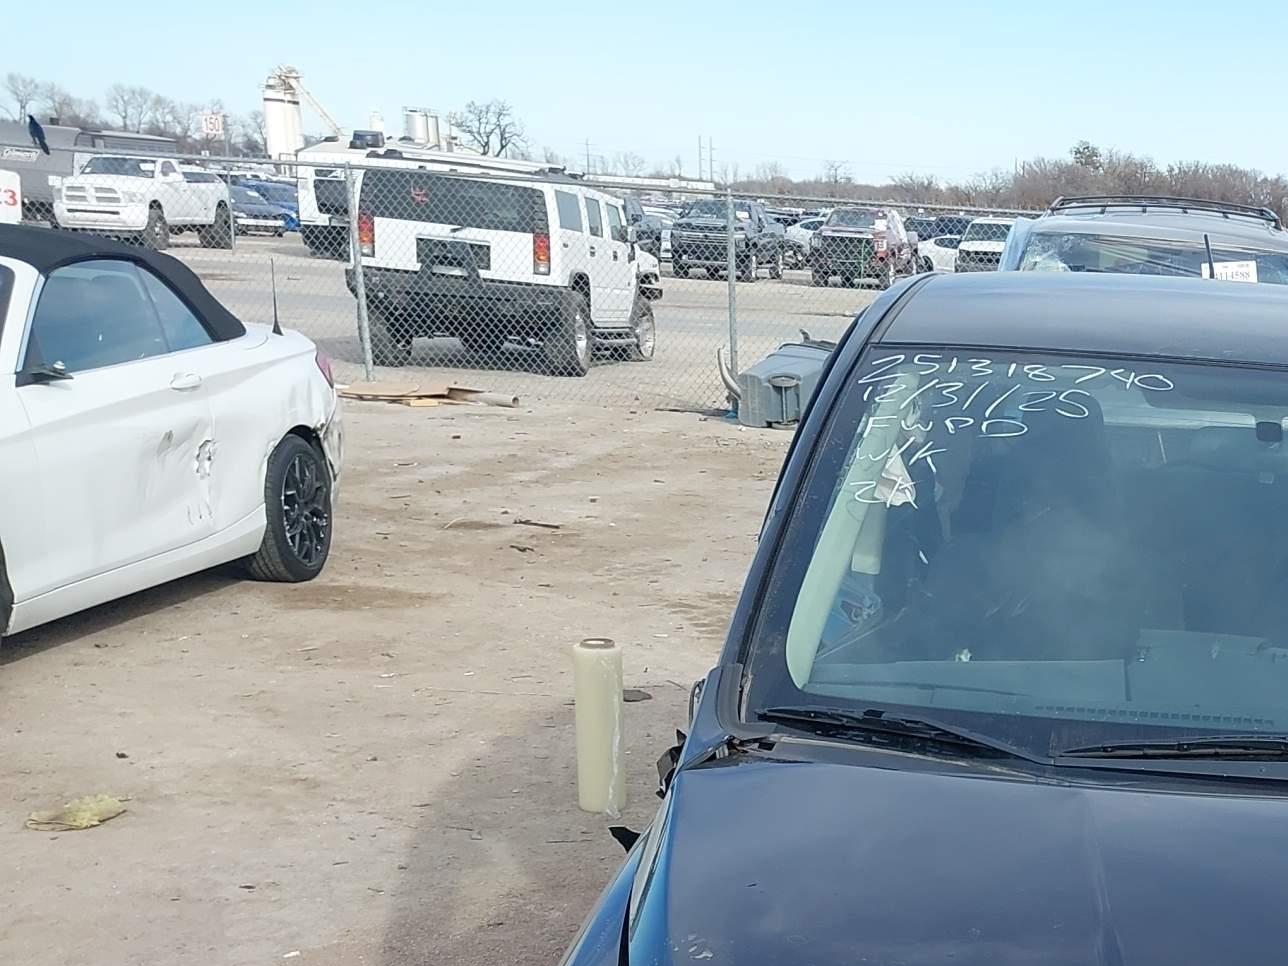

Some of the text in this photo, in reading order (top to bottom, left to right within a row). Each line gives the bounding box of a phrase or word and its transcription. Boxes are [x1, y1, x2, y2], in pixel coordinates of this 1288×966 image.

[0, 188, 18, 207] 3
[858, 354, 1175, 391] 251318740
[863, 379, 1091, 418] 12/31/25
